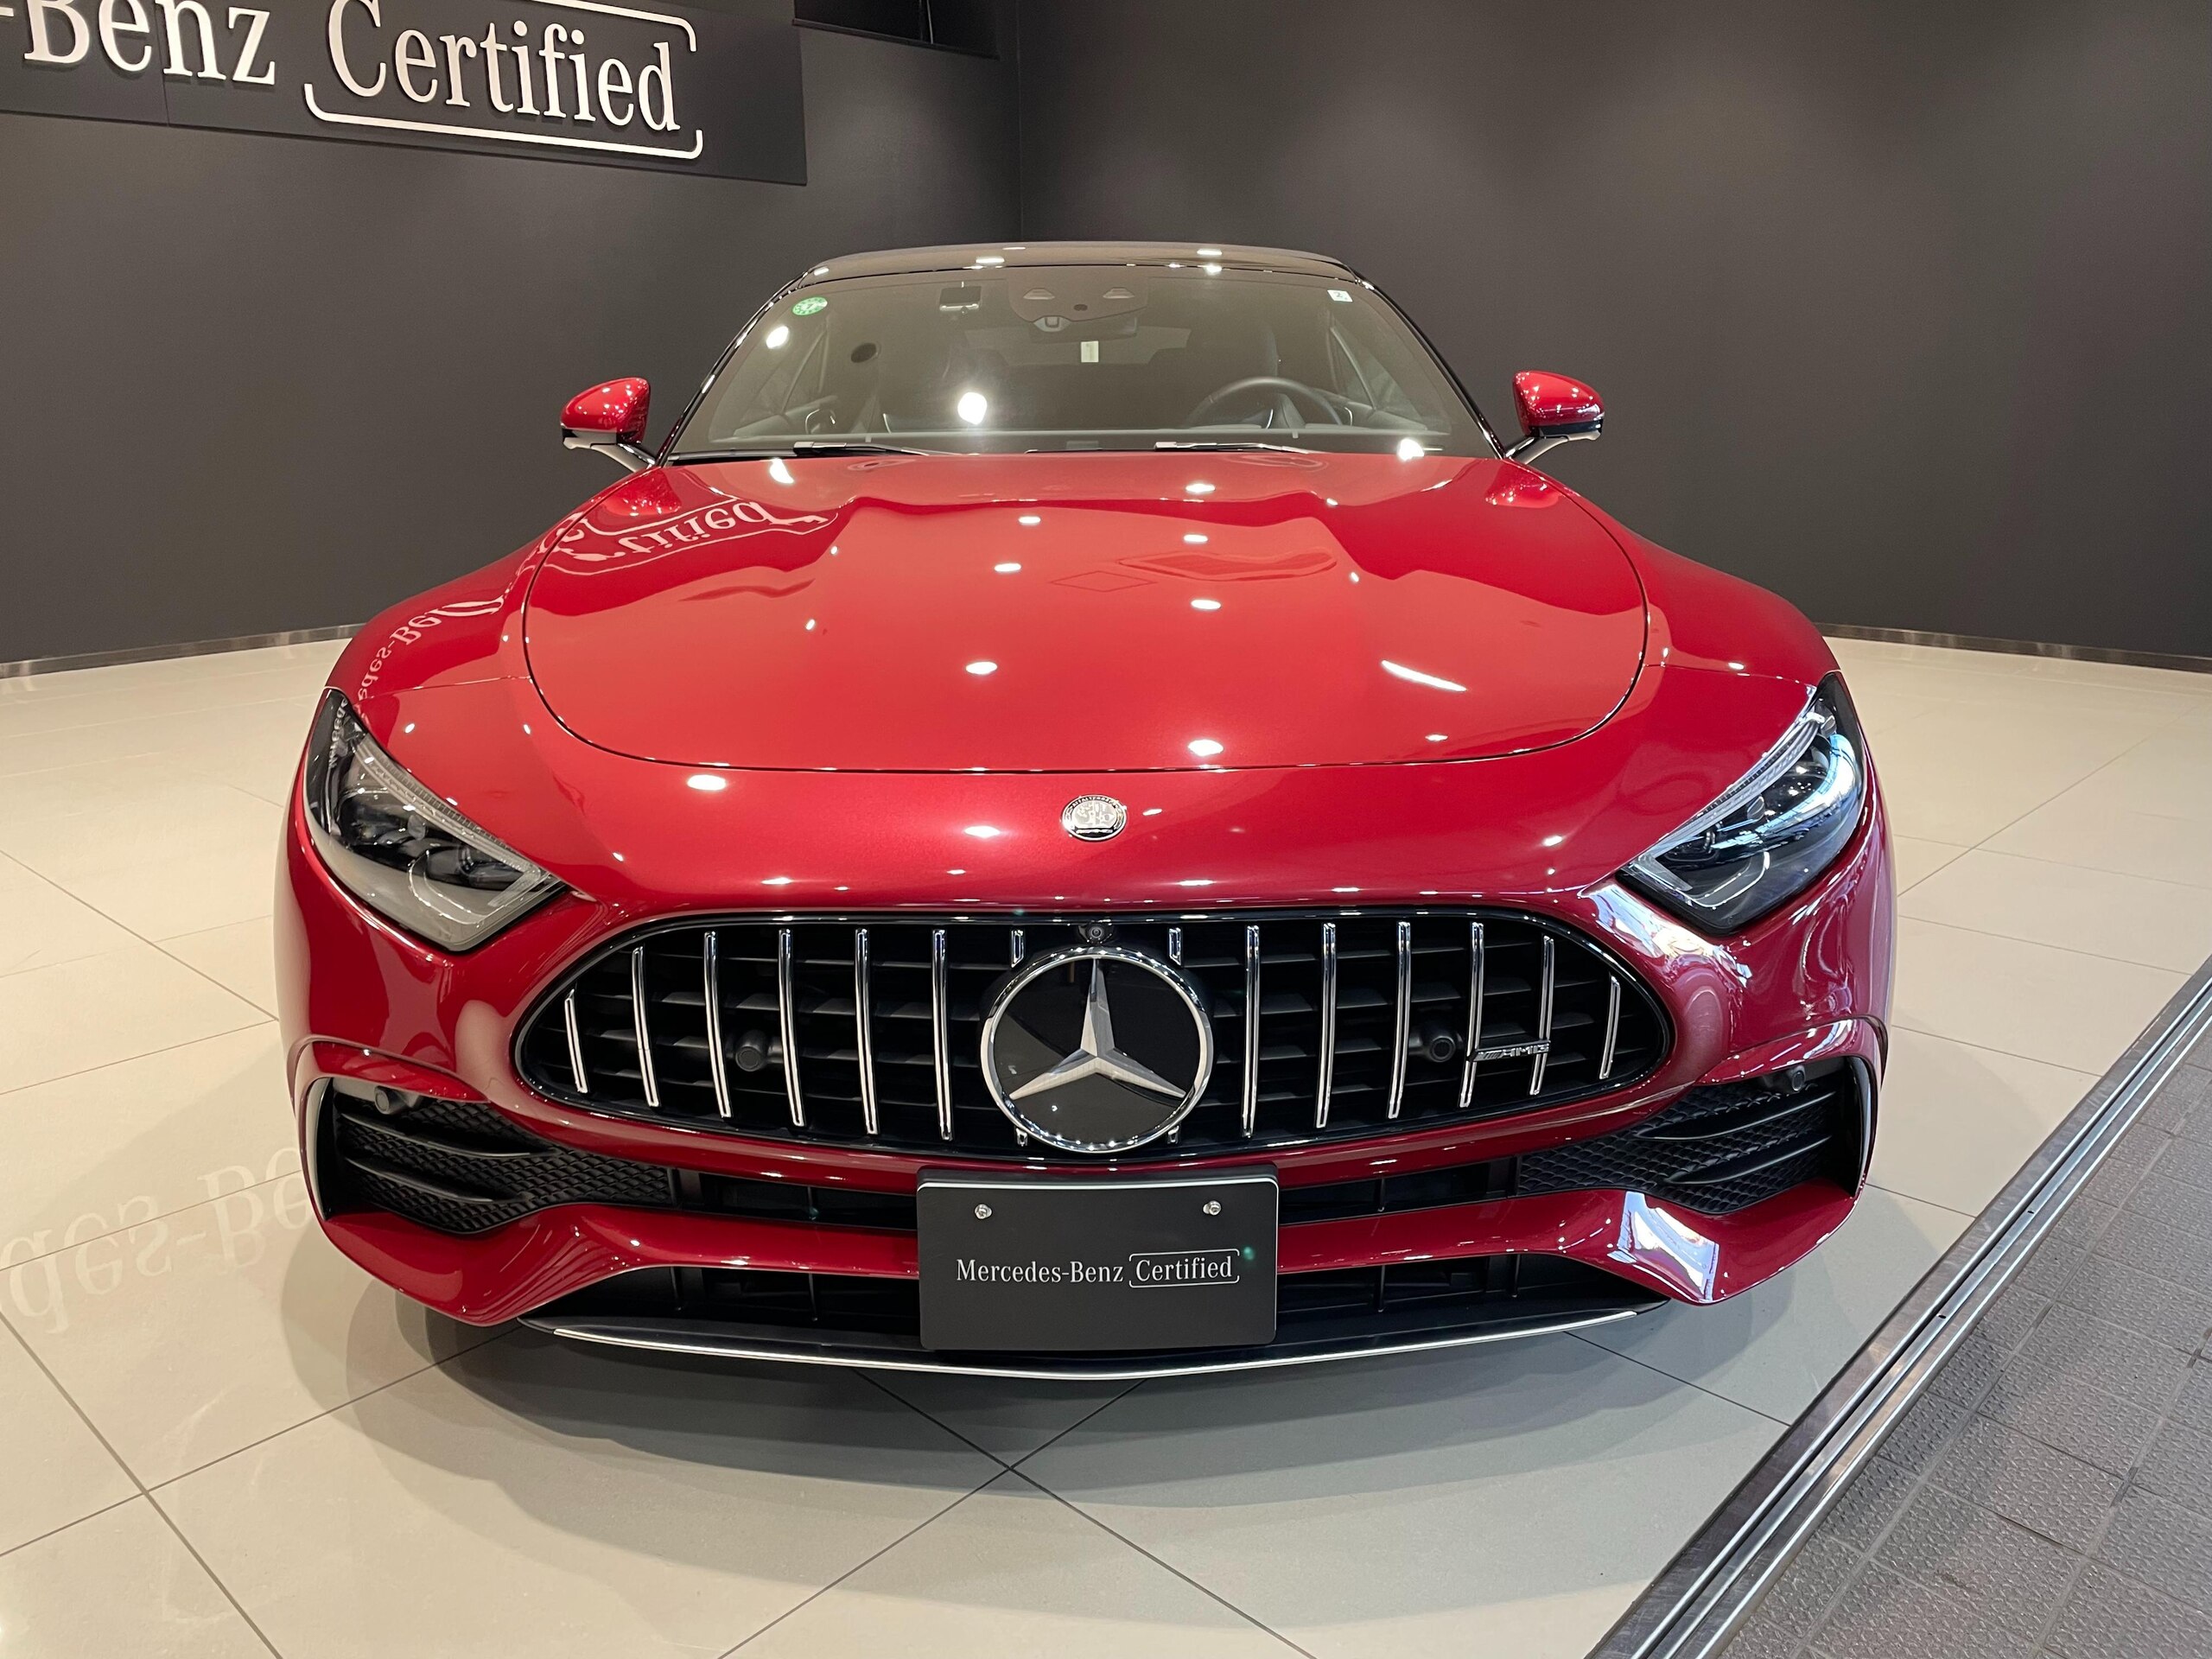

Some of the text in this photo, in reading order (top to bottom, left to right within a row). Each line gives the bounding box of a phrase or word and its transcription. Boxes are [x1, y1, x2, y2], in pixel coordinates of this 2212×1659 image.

[328, 0, 681, 131] Certified
[956, 1255, 1233, 1283] Mercedes-Benz Certified
